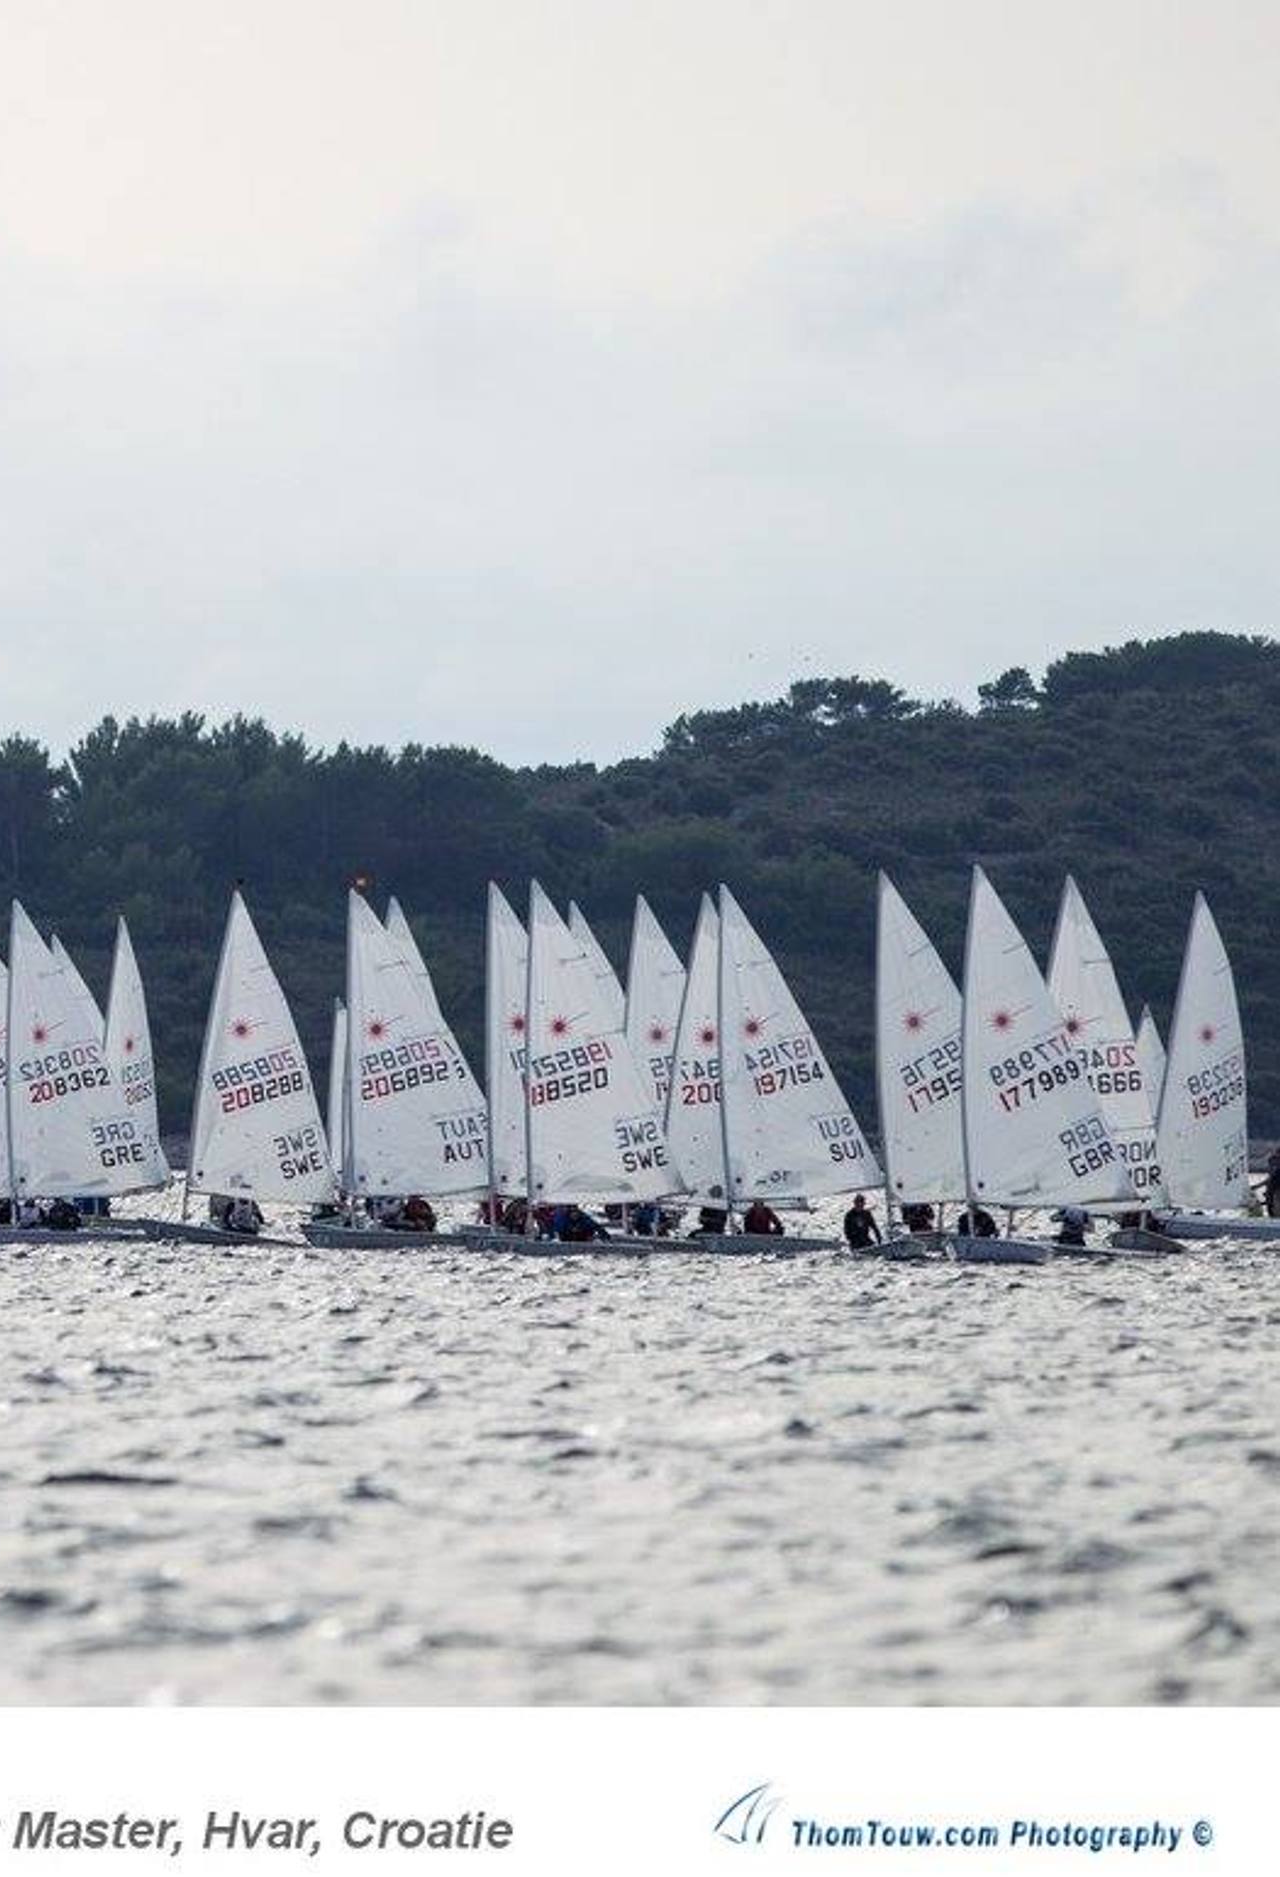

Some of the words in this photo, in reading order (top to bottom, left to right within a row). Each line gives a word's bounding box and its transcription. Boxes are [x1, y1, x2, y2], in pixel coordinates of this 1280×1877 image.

[29, 1067, 111, 1104] 208362
[221, 1071, 304, 1114] 208288
[360, 1060, 449, 1102] 206892
[754, 1061, 823, 1096] 197154
[998, 1060, 1079, 1112] 177989
[101, 1143, 146, 1168] GRE
[280, 1151, 324, 1180] SWE
[444, 1138, 484, 1164] AUT
[622, 1146, 669, 1173] SWE
[829, 1137, 865, 1162] SUI
[1069, 1141, 1116, 1178] GBR
